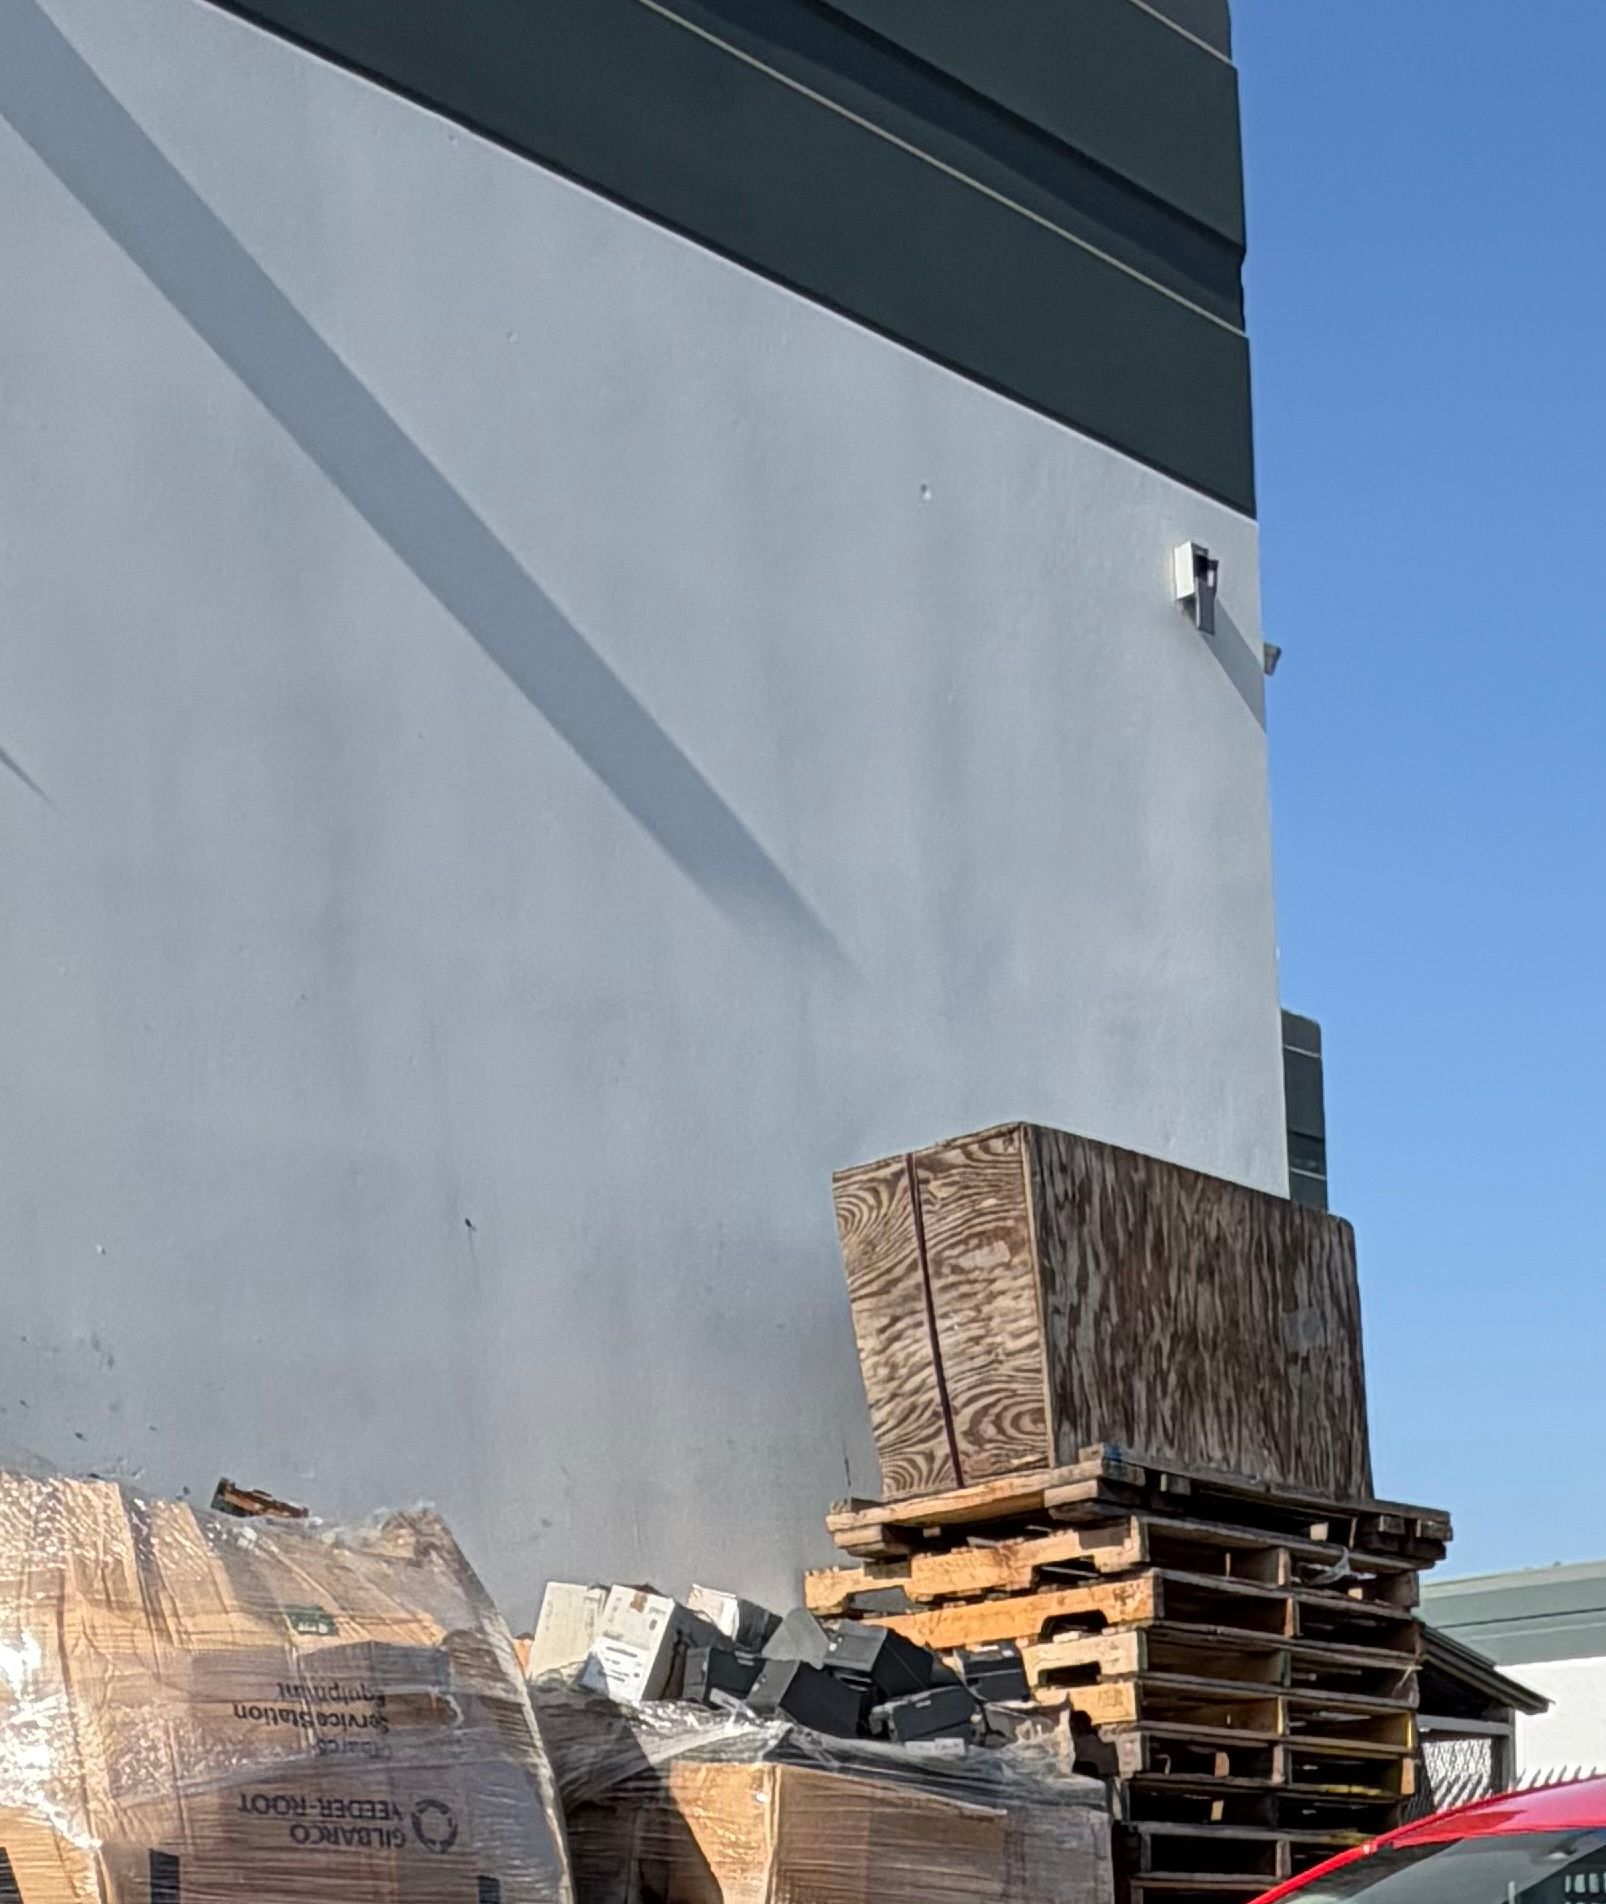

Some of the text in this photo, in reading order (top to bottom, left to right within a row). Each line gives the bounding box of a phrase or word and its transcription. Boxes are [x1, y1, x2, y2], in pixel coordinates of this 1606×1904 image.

[232, 1702, 389, 1735] Service Station
[290, 1823, 406, 1849] GILBARCO
